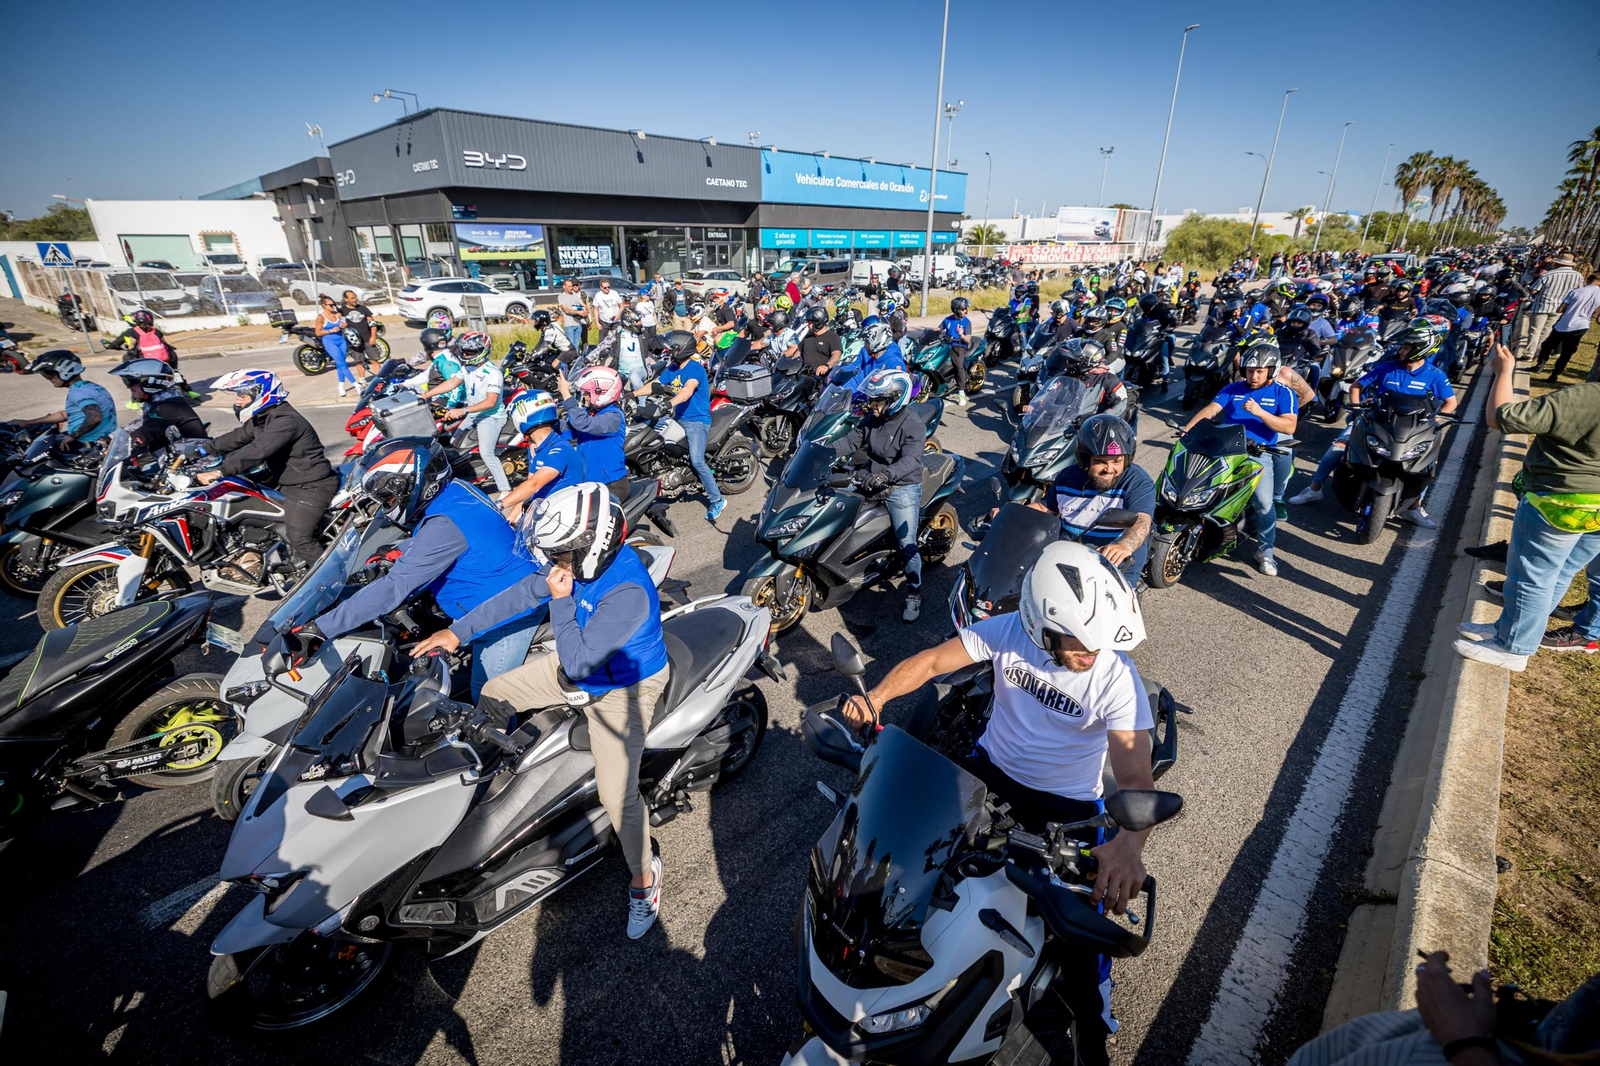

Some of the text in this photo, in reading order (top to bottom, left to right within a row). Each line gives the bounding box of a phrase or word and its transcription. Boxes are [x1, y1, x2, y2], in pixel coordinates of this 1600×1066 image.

[412, 159, 439, 173] CAETANO TEC
[463, 150, 527, 171] BYD
[336, 169, 356, 187] BYD
[706, 177, 748, 188] CAETANO TEC
[795, 173, 915, 194] Vehículos Comerciales de Ocasión
[558, 251, 599, 260] NUEVO
[1032, 245, 1082, 254] COMPRA
